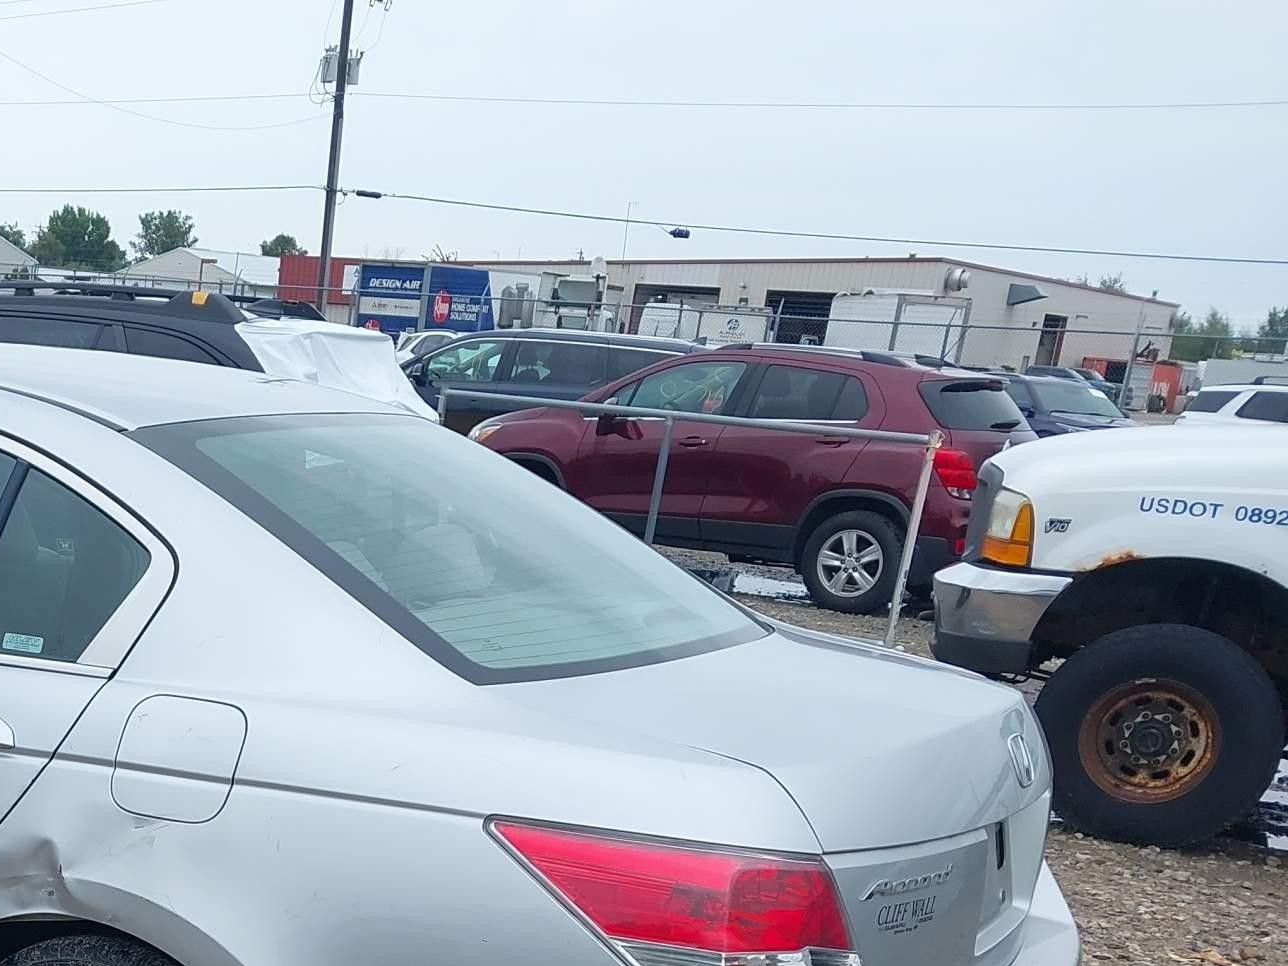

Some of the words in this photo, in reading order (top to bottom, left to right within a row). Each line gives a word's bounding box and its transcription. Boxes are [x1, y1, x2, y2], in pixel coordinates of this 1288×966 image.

[369, 278, 402, 289] DESIGN
[402, 280, 421, 290] AIR
[1139, 497, 1224, 519] USDOT
[1234, 506, 1288, 526] 0892
[1044, 520, 1069, 534] V10
[877, 902, 911, 926] CLIFF
[912, 896, 937, 919] WALL
